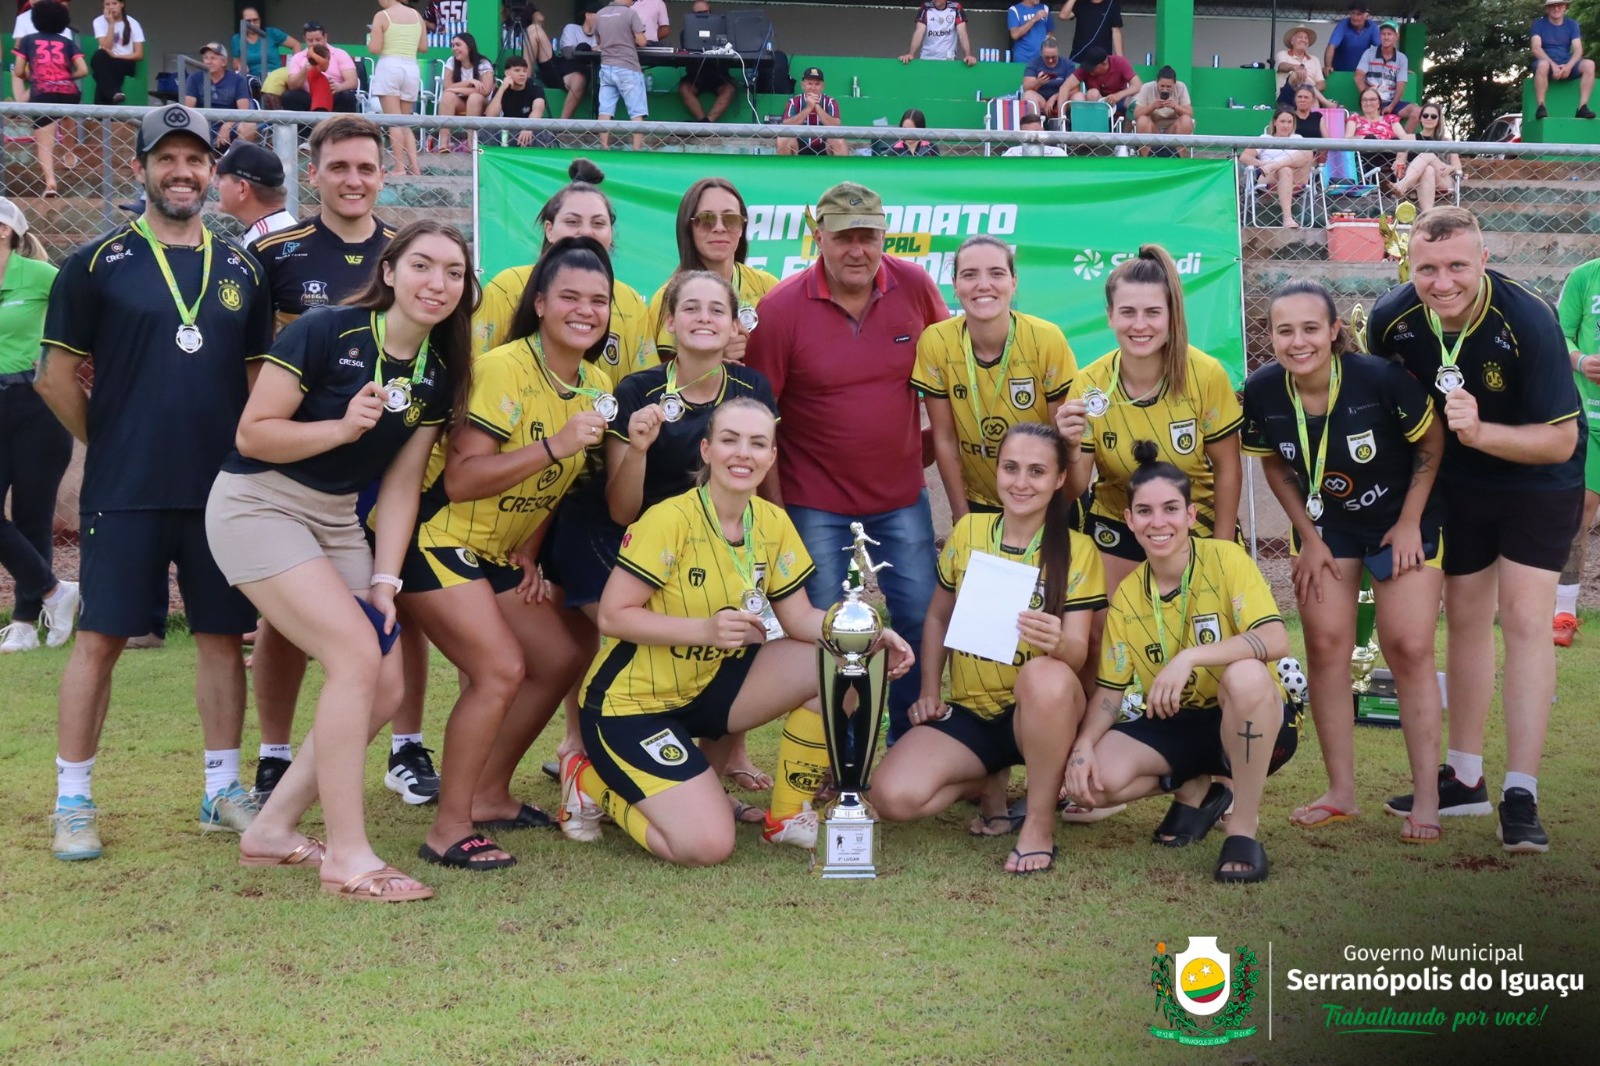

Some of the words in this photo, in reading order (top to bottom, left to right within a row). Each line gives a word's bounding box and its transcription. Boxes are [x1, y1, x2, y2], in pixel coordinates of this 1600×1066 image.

[34, 39, 65, 64] 33
[745, 203, 1018, 241] AMONATO
[339, 358, 365, 368] CRESOL
[498, 495, 557, 513] CRESOL
